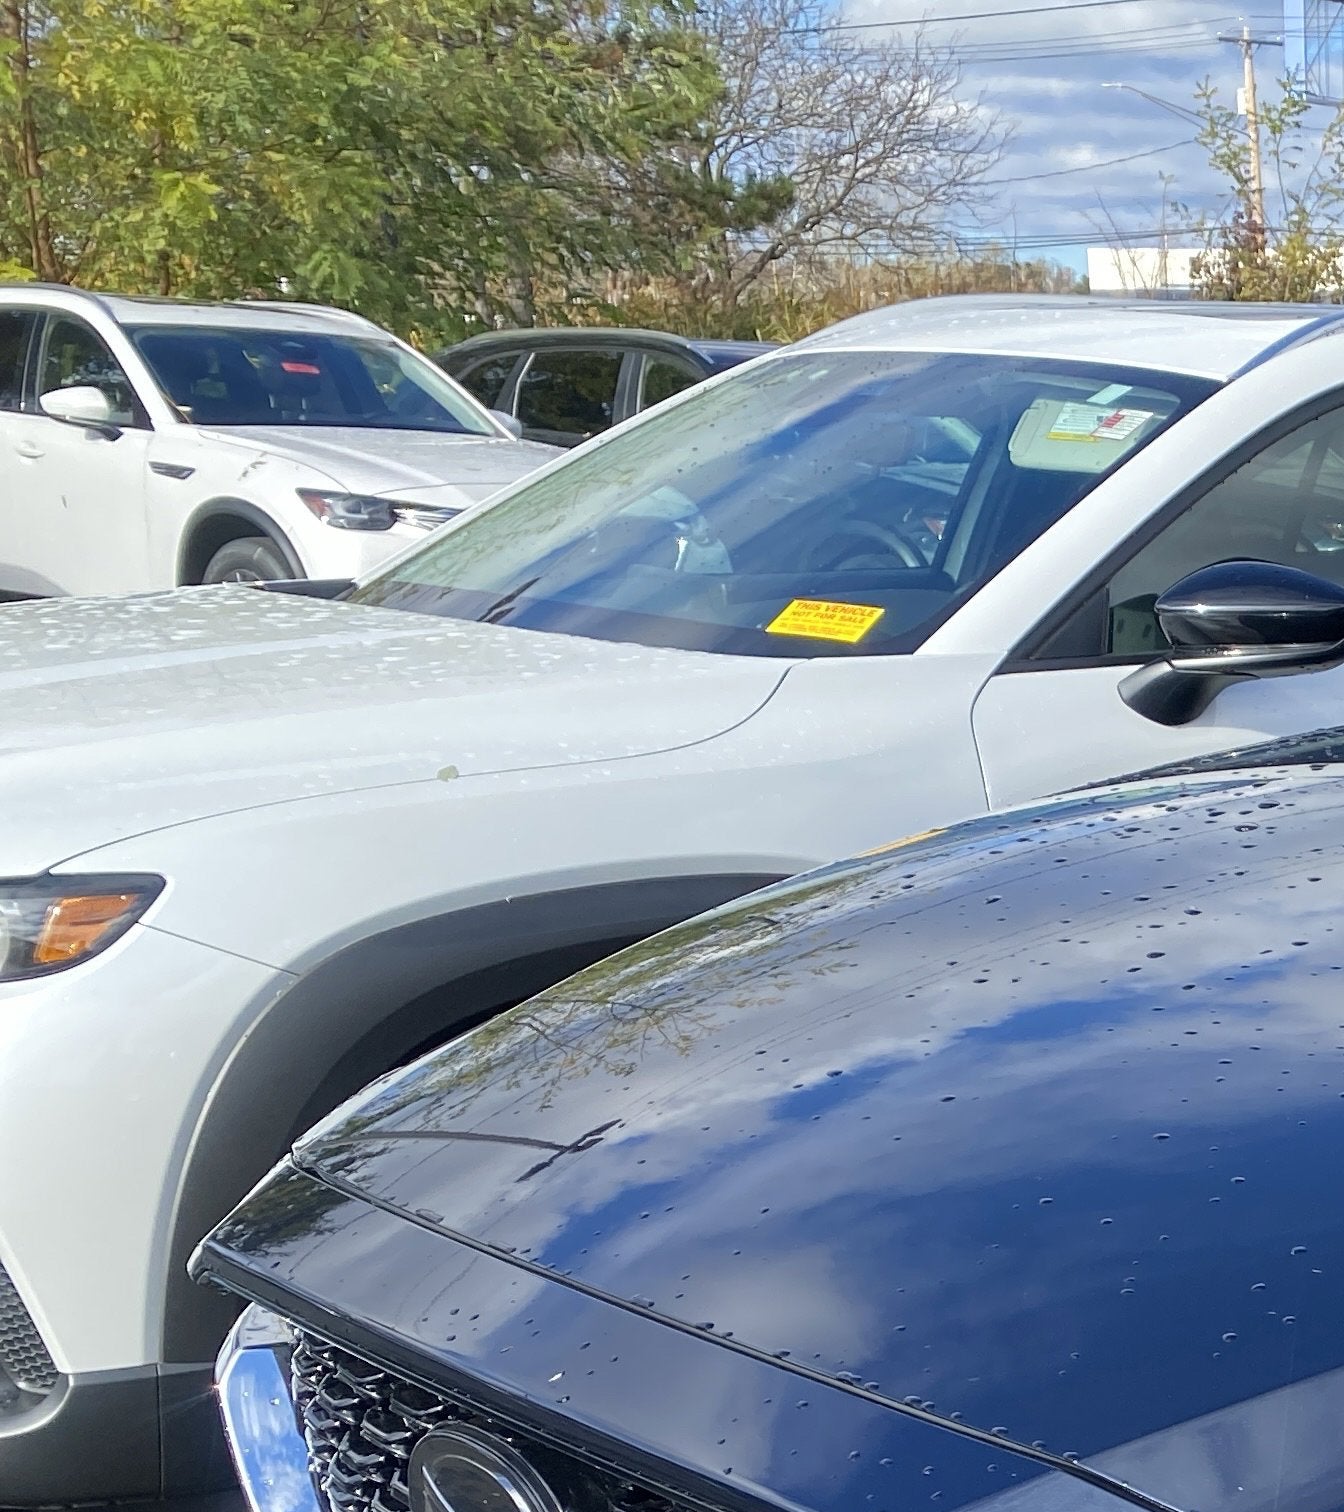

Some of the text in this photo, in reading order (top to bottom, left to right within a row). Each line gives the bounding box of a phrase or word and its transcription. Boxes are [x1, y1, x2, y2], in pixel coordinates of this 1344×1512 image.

[791, 610, 810, 618] NOT
[813, 611, 835, 621] FOR
[839, 614, 866, 624] SALE
[795, 601, 879, 618] THIS VEHICLE
